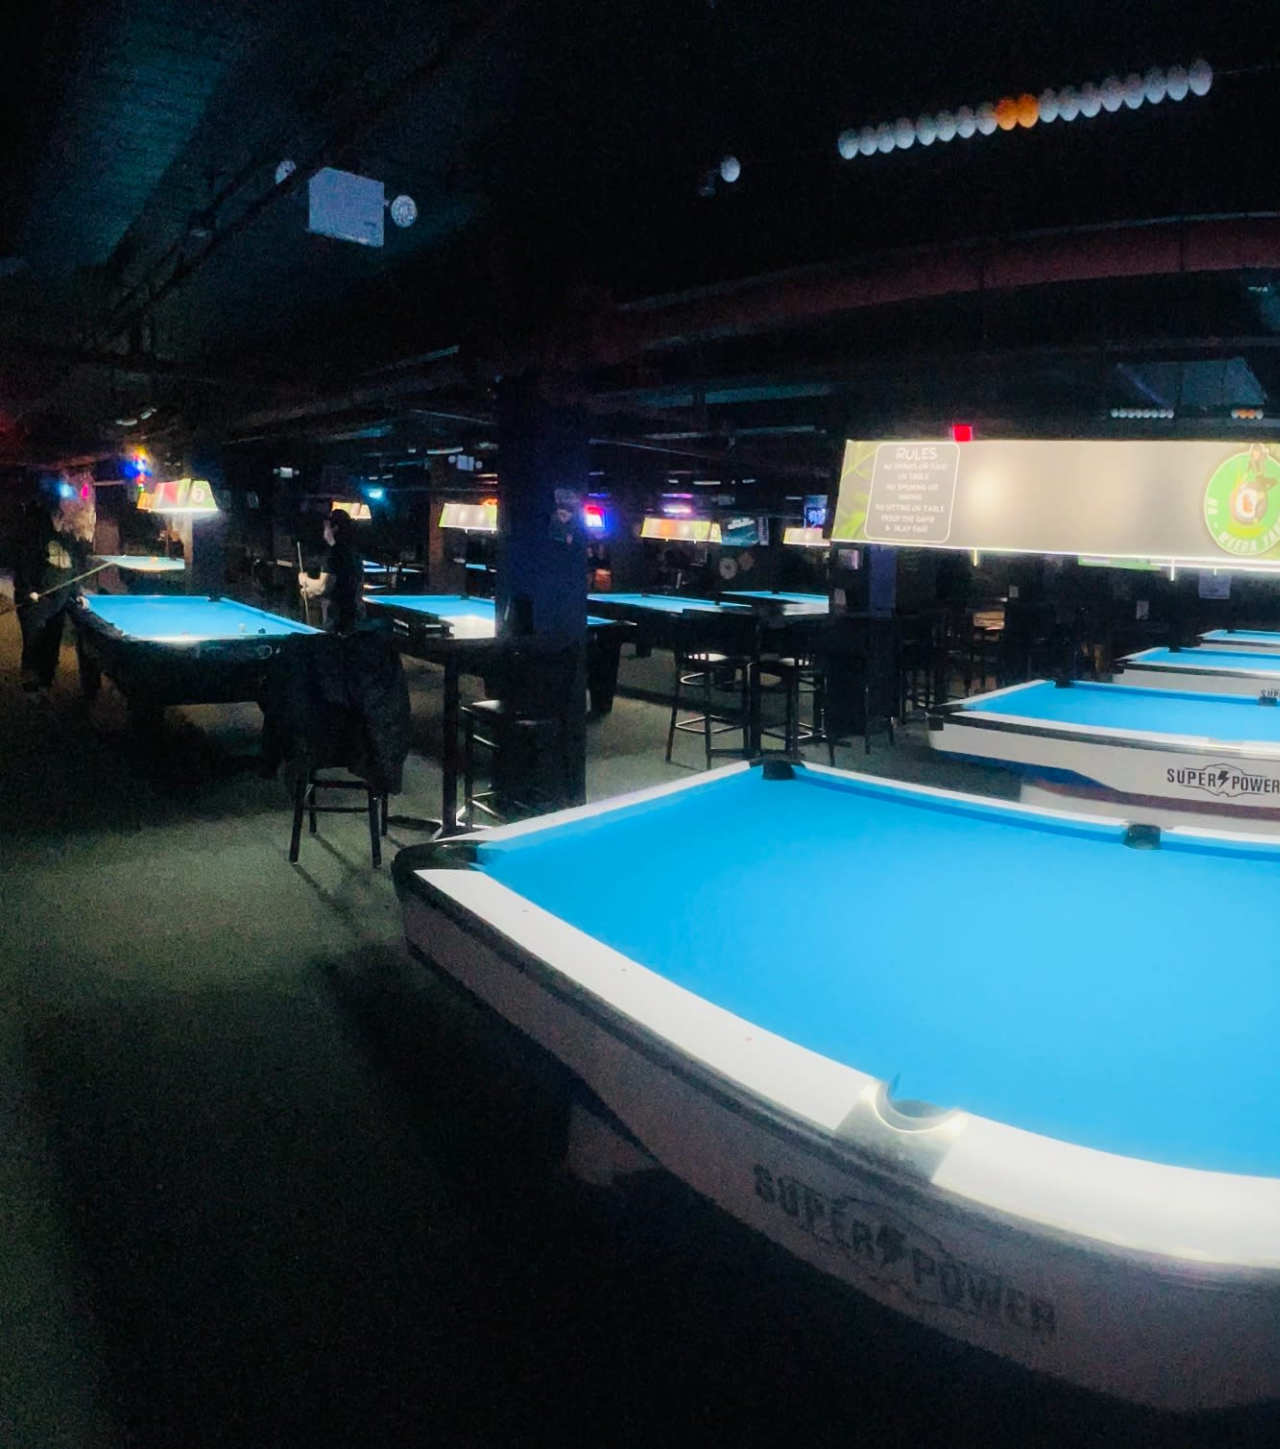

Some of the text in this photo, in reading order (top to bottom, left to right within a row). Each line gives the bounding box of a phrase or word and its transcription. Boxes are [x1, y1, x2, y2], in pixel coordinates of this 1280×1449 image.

[895, 447, 938, 461] RULES
[1166, 768, 1280, 794] SUPER POWER
[752, 1163, 1057, 1333] SUPER POWER
